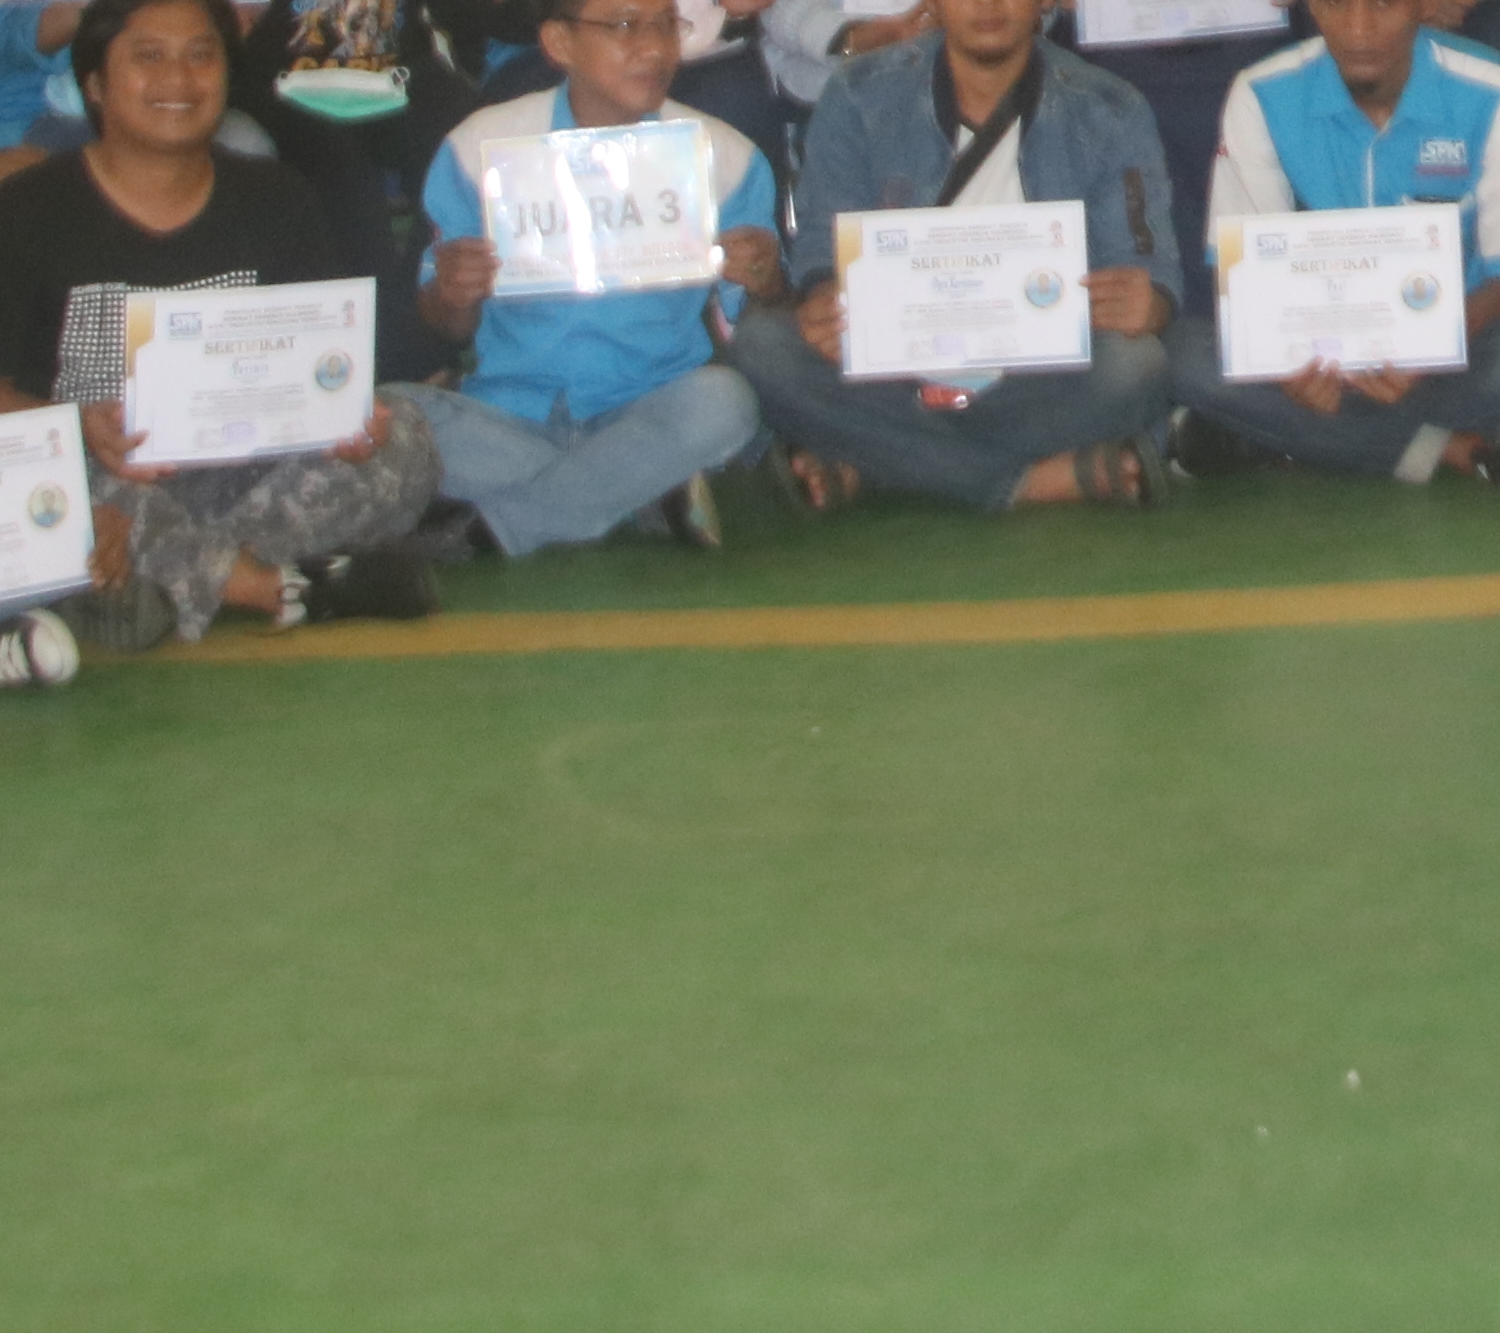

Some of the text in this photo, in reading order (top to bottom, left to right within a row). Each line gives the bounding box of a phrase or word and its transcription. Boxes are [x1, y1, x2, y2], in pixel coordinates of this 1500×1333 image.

[513, 188, 682, 239] JURA 3
[910, 251, 1002, 270] SERTIFIKAT
